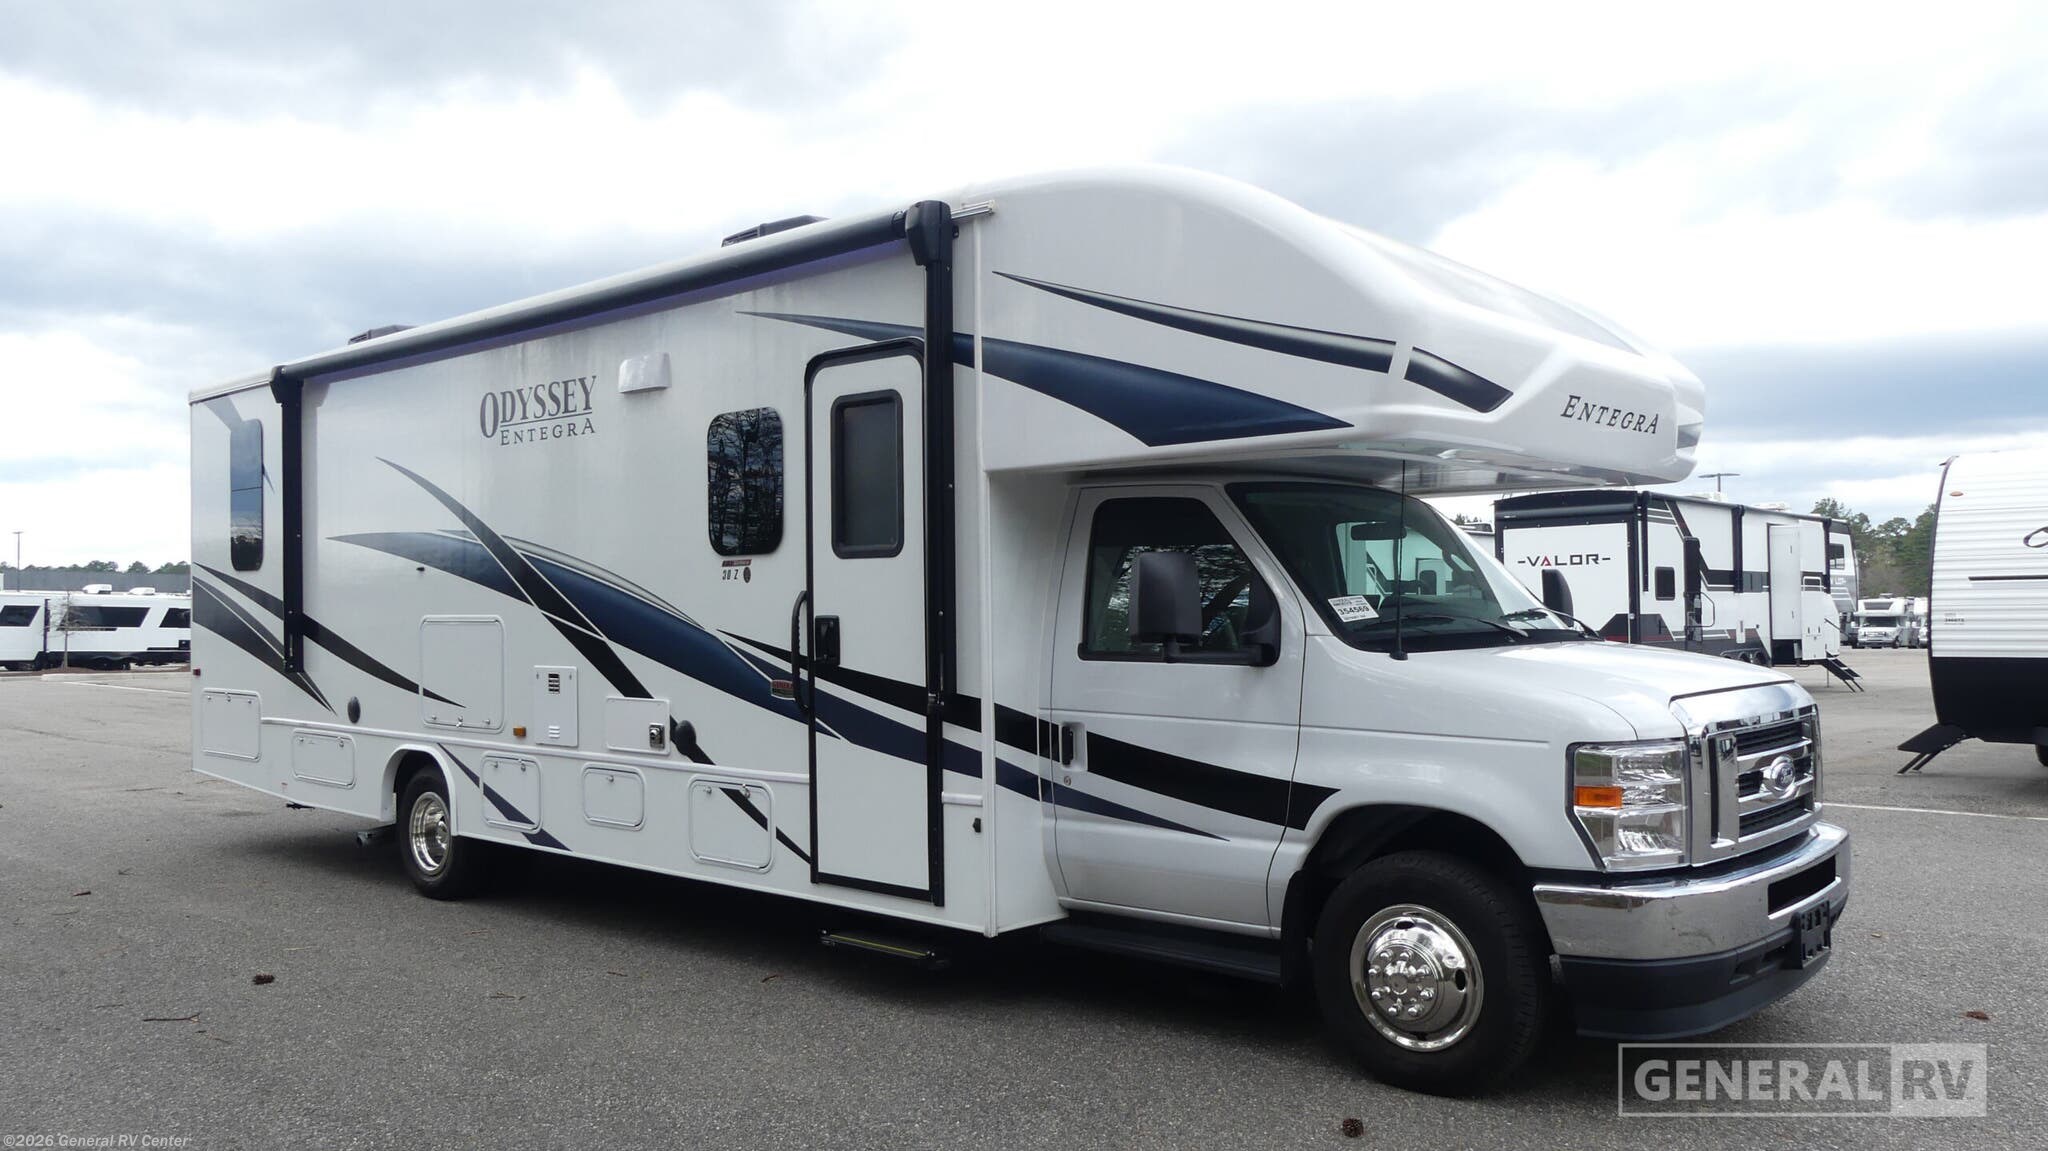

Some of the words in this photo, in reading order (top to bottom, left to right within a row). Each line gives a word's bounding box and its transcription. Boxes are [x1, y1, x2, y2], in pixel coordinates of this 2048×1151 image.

[480, 375, 596, 438] ODYSSEY
[1560, 395, 1659, 434] ENTEGRA
[500, 417, 596, 446] ENTEGRA
